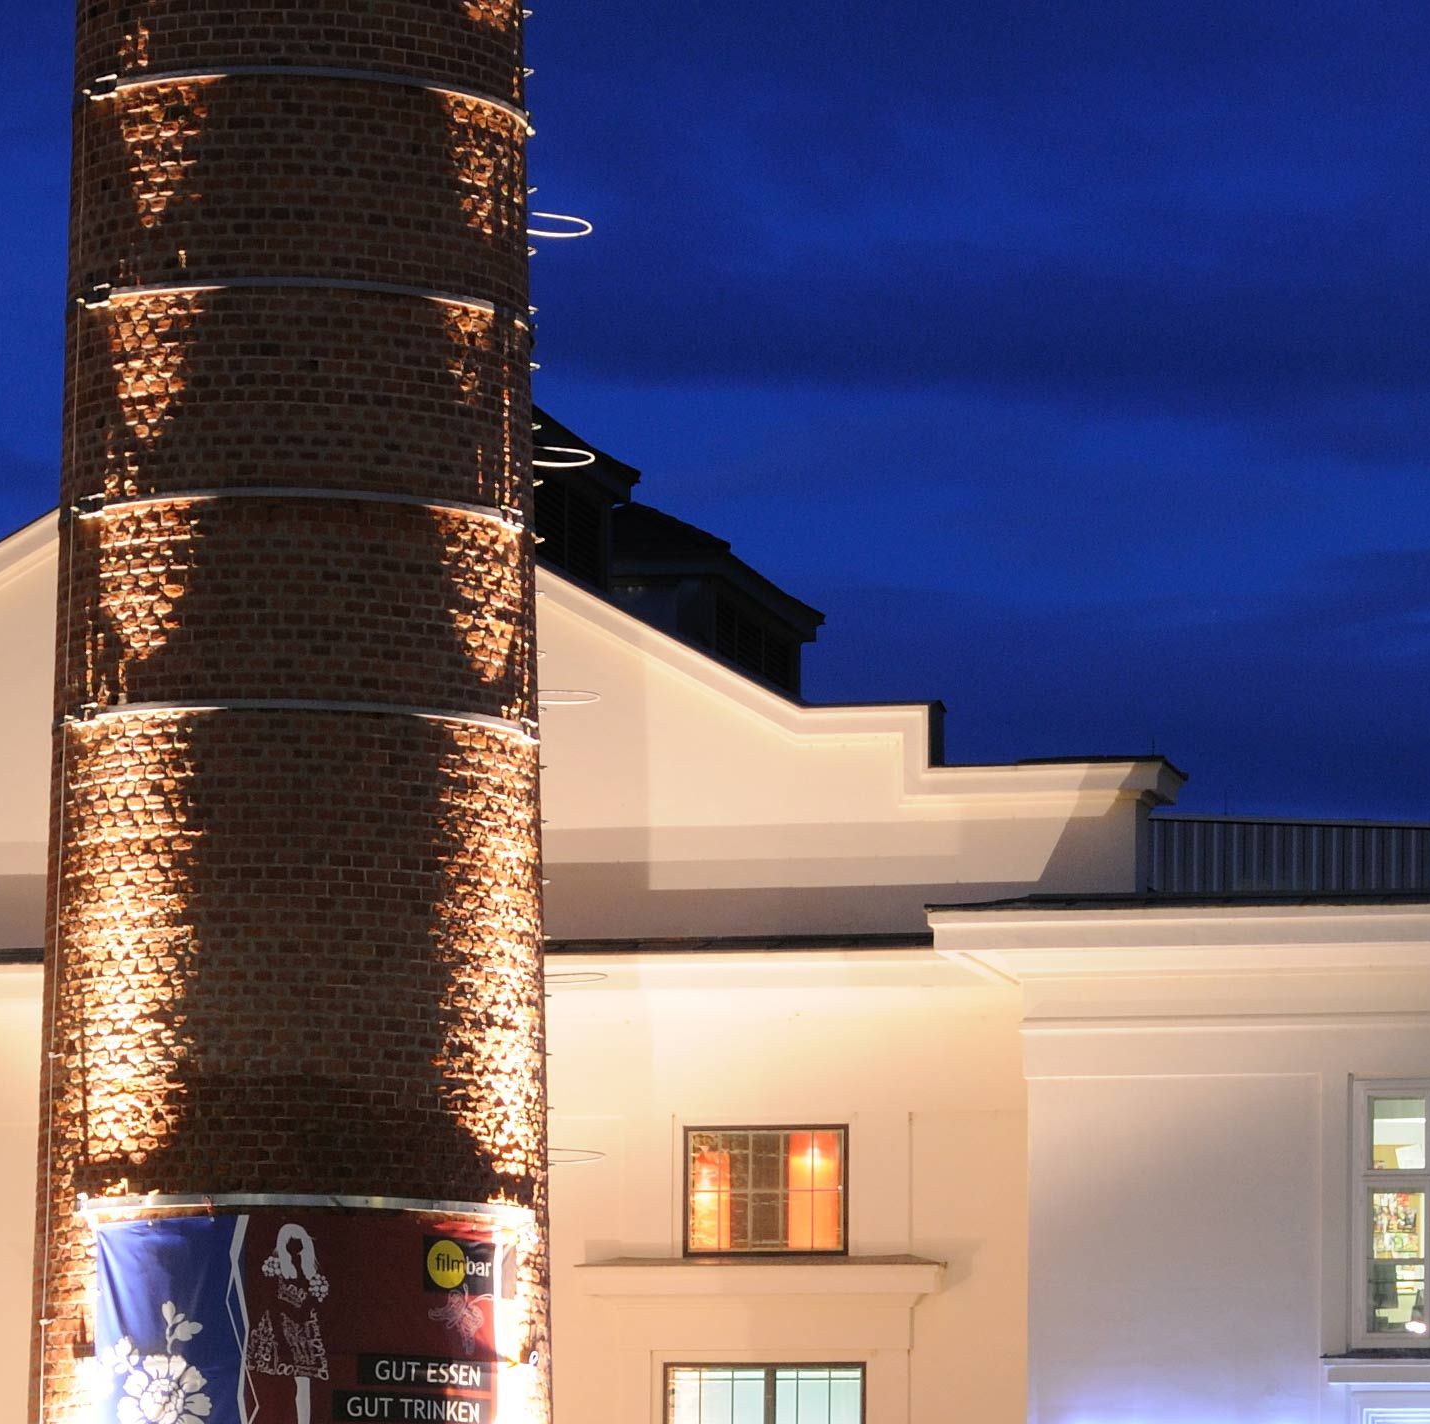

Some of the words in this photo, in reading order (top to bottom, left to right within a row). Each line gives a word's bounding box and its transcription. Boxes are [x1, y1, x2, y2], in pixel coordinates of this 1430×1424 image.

[435, 1253, 492, 1278] filmbar
[375, 1360, 421, 1381] GUT
[426, 1362, 481, 1387] ESSEN
[347, 1396, 393, 1417] GUT
[399, 1398, 480, 1424] TRINKEN
